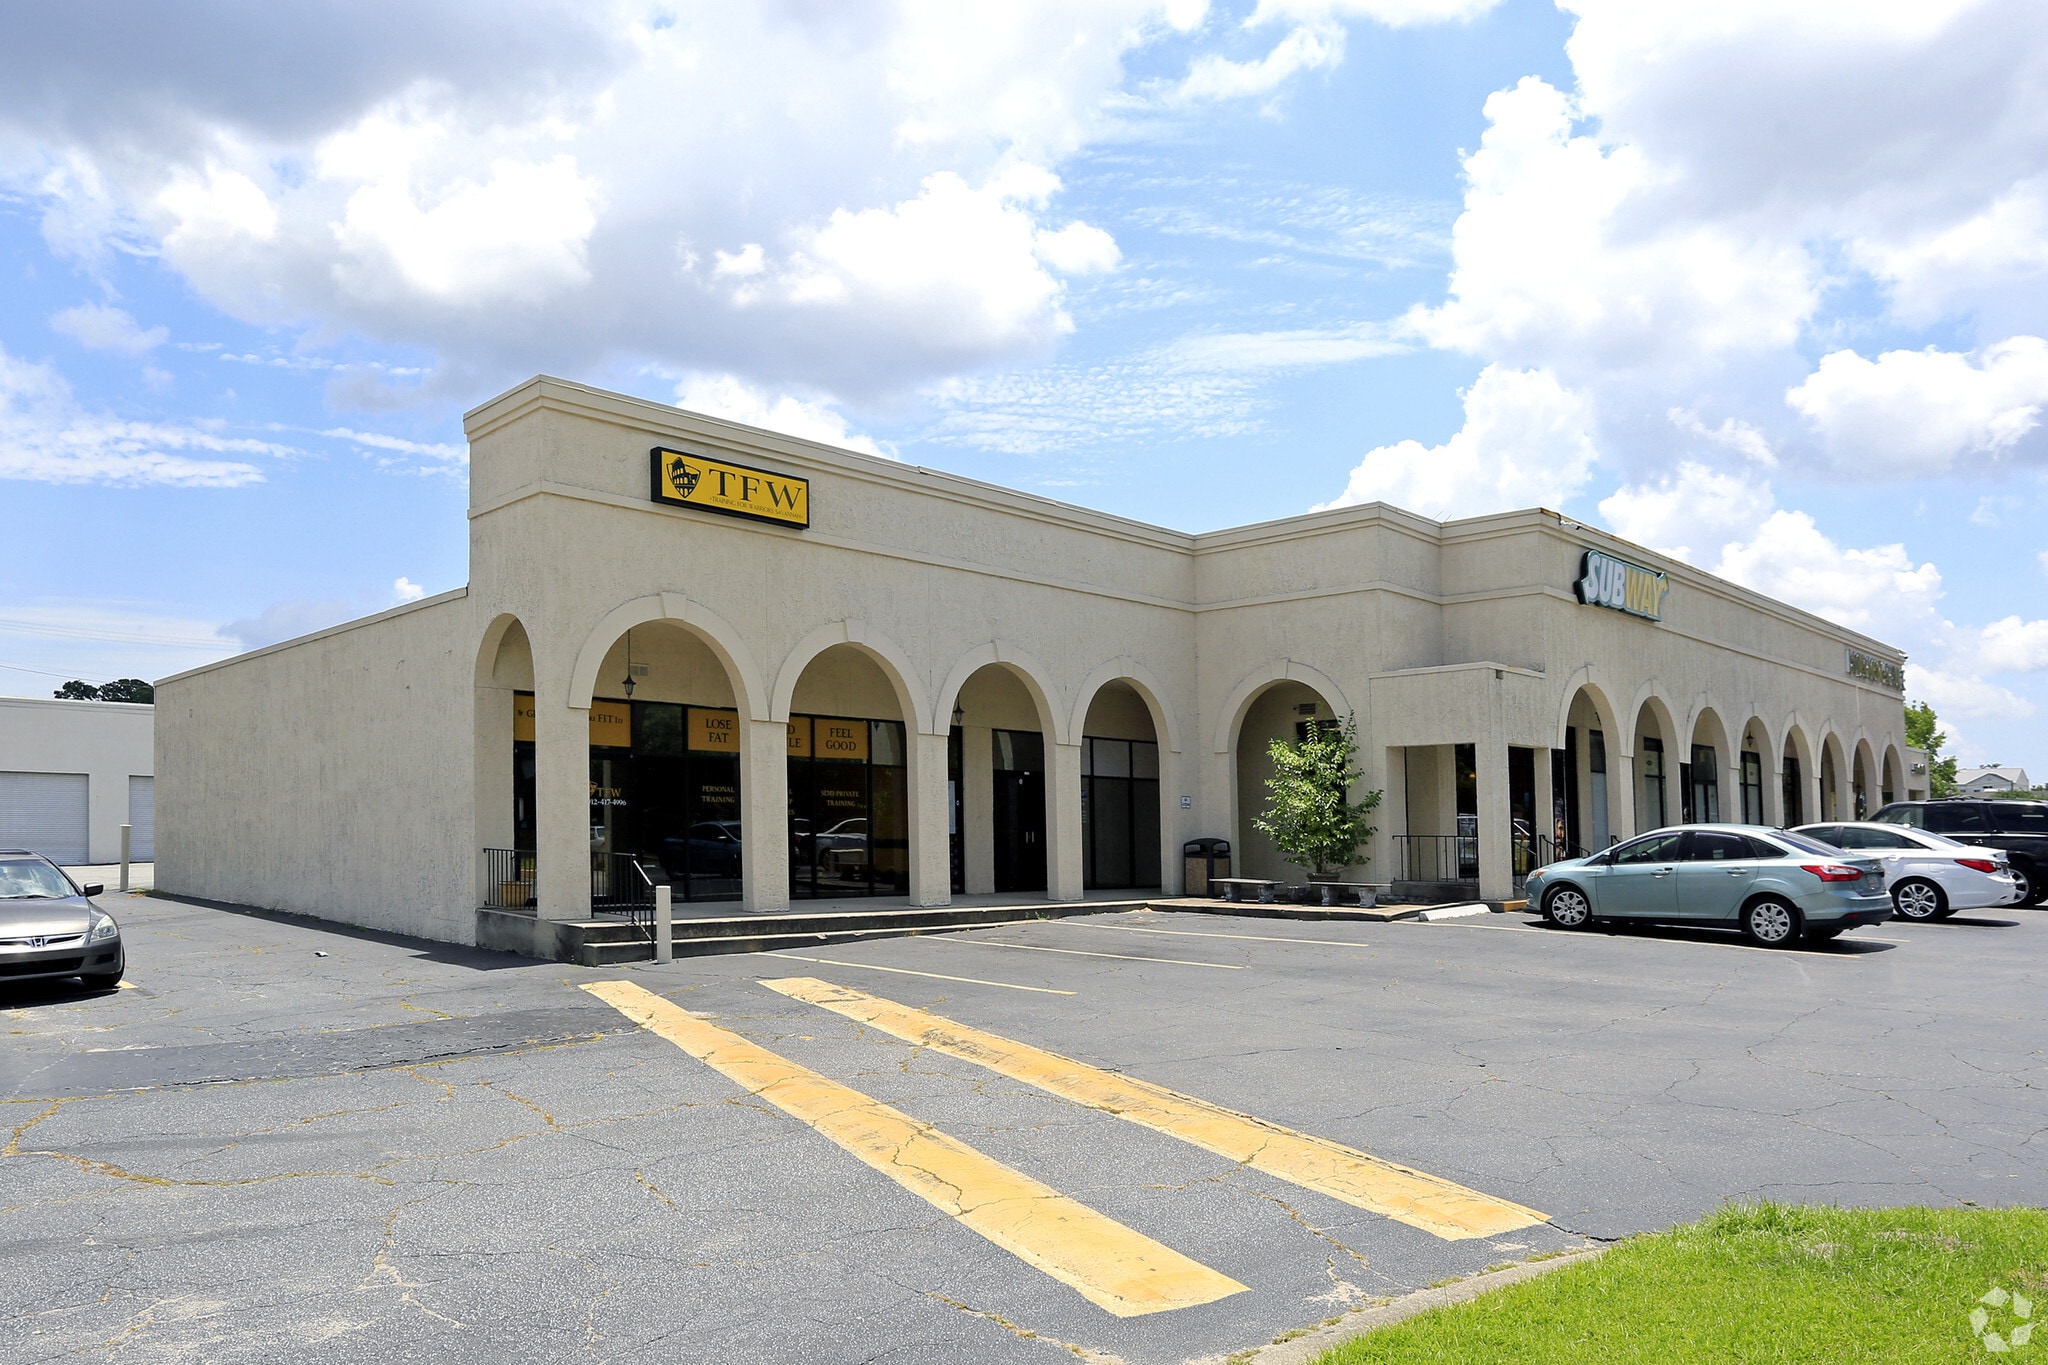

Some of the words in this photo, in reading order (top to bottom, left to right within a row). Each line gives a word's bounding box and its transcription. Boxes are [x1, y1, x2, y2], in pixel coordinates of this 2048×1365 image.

[709, 469, 803, 511] TFW
[1586, 554, 1668, 617] SUBWAY
[598, 714, 613, 723] FIT
[706, 718, 732, 730] LOSE
[709, 732, 729, 743] FAT
[829, 727, 853, 738] FEEL
[825, 740, 857, 751] GOOD
[597, 787, 622, 798] TFW
[702, 785, 735, 793] PERSONAL
[820, 789, 860, 798] SEMI-PRIVATE
[701, 795, 735, 803] TRAINING
[826, 799, 856, 807] TRAINING
